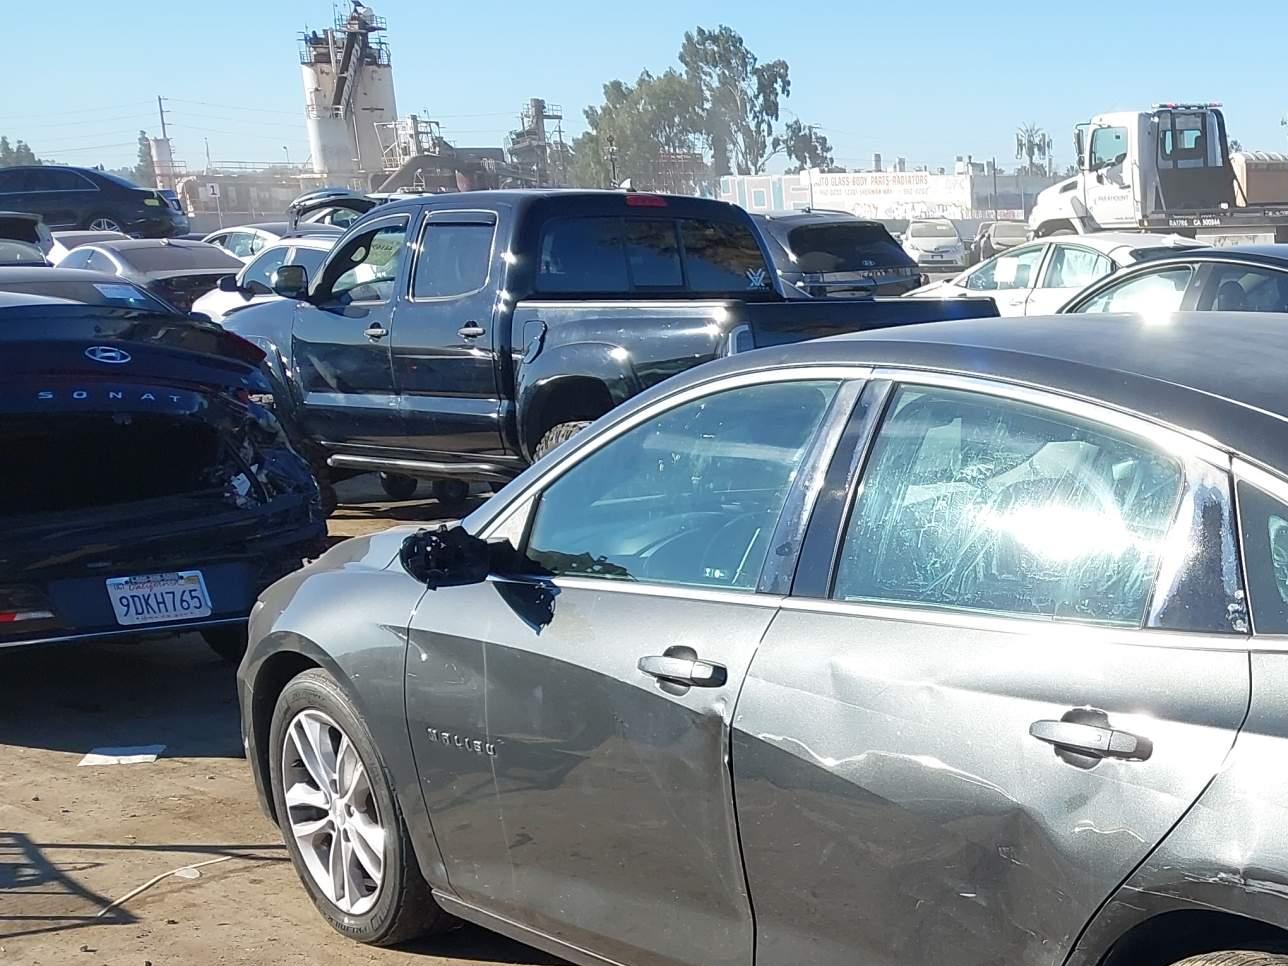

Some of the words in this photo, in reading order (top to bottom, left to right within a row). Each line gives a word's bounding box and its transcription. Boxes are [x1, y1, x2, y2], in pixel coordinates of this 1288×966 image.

[831, 176, 850, 186] GLASS
[853, 176, 867, 186] BODY
[871, 175, 889, 186] PARTS
[892, 175, 928, 185] RADIATORS
[119, 589, 202, 616] 9DKH765
